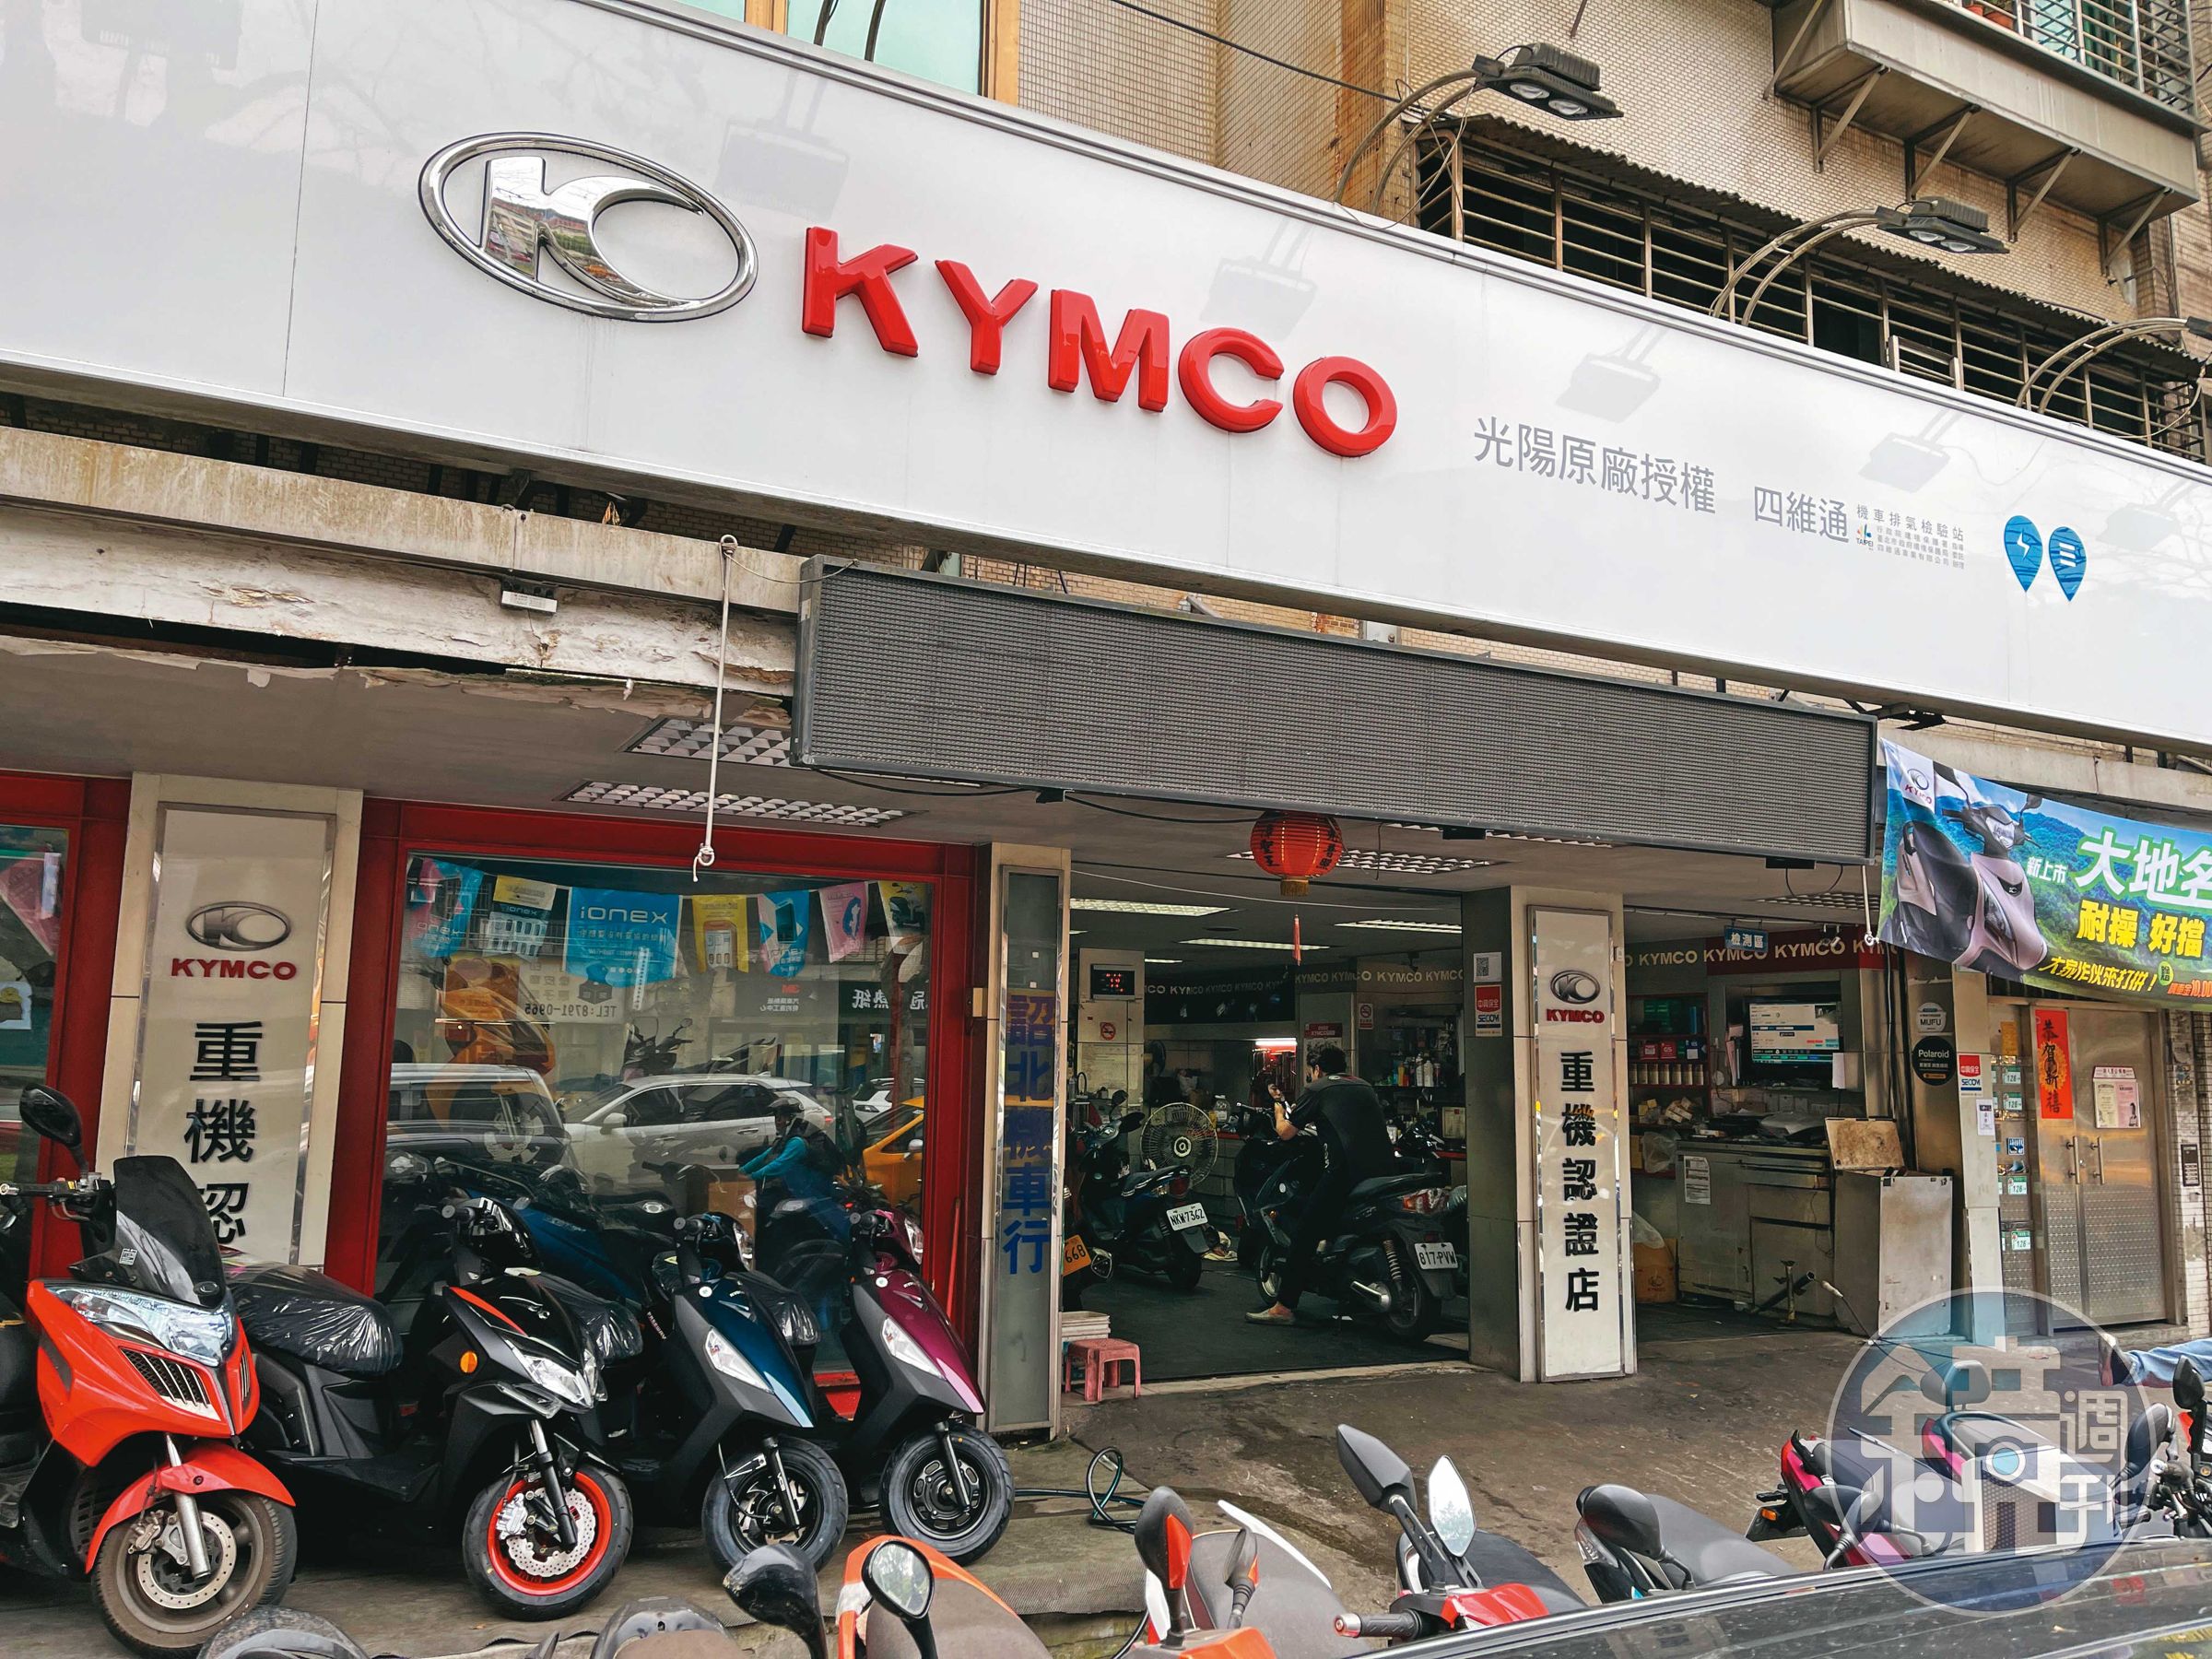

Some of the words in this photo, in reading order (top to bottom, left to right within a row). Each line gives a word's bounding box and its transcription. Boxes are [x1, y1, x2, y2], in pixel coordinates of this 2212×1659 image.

[801, 226, 1399, 457] KYMCO
[1475, 416, 1716, 515] 光陽原廠授權
[1754, 485, 1849, 545] 四維通
[1856, 503, 1964, 542] 機車排氣檢驗站
[2027, 856, 2068, 884] 新上市
[580, 906, 668, 924] ionex
[1730, 932, 1764, 949] 檢測區
[2077, 900, 2139, 948] 耐操
[2147, 912, 2206, 959] 好擋
[1639, 949, 1698, 966] KYMCO
[1774, 939, 1845, 959] KYMCO
[171, 958, 296, 982] KYMCO
[1376, 971, 1423, 982] KYMCO
[1478, 1014, 1500, 1023] SECOM
[1546, 1008, 1606, 1024] KYMCO
[1918, 1049, 1949, 1058] Polaroid
[1560, 1051, 1600, 1313] 重機認證店
[1170, 1208, 1206, 1226] NKW-7362
